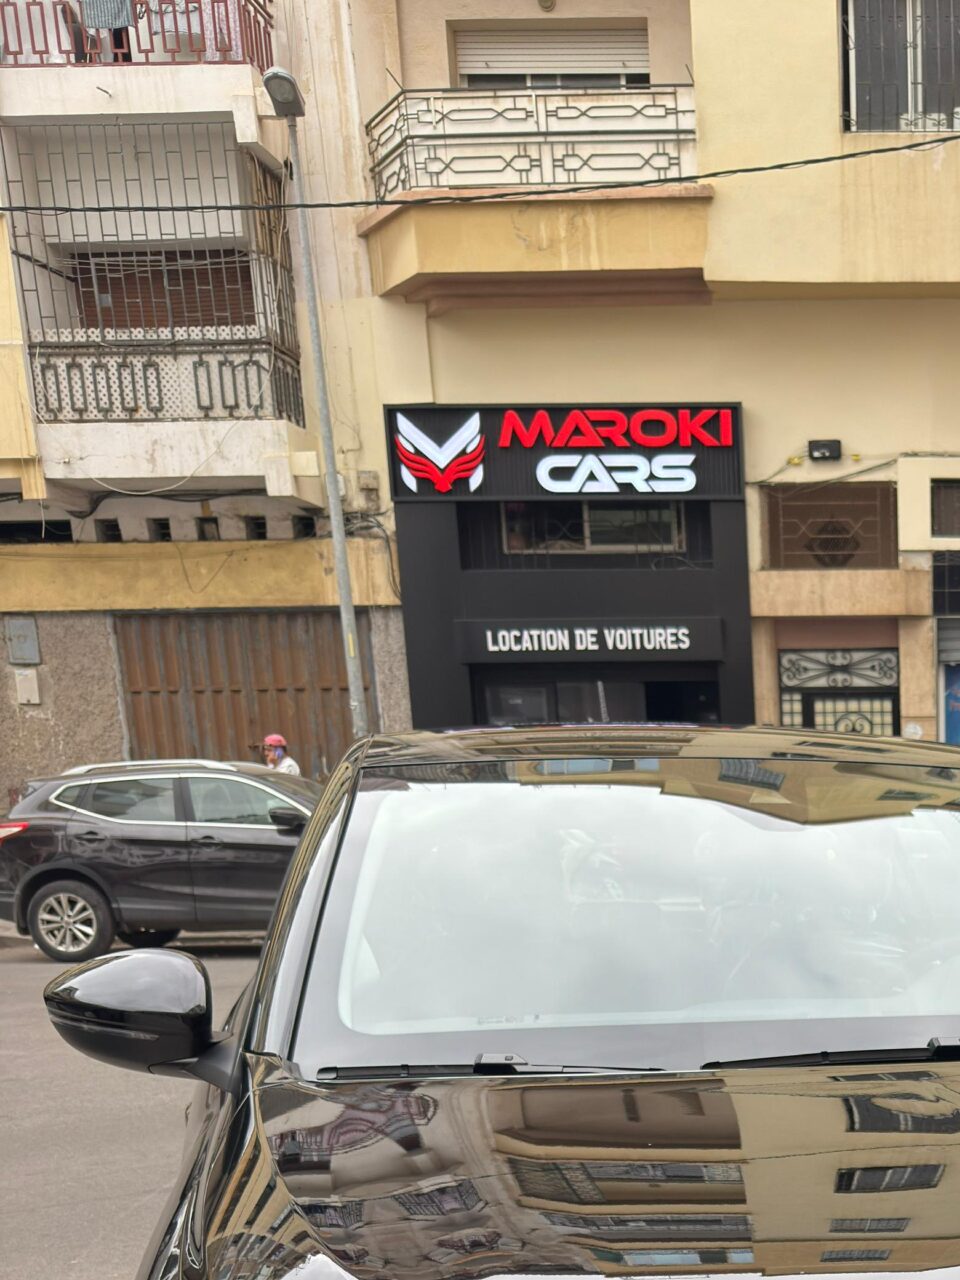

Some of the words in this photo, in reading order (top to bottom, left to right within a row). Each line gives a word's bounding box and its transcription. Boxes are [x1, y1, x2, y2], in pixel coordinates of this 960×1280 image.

[499, 409, 733, 448] MAROKI
[535, 453, 697, 493] CARS
[486, 629, 570, 652] LOCATION
[573, 629, 600, 651] DE
[603, 628, 691, 651] VOITURES
